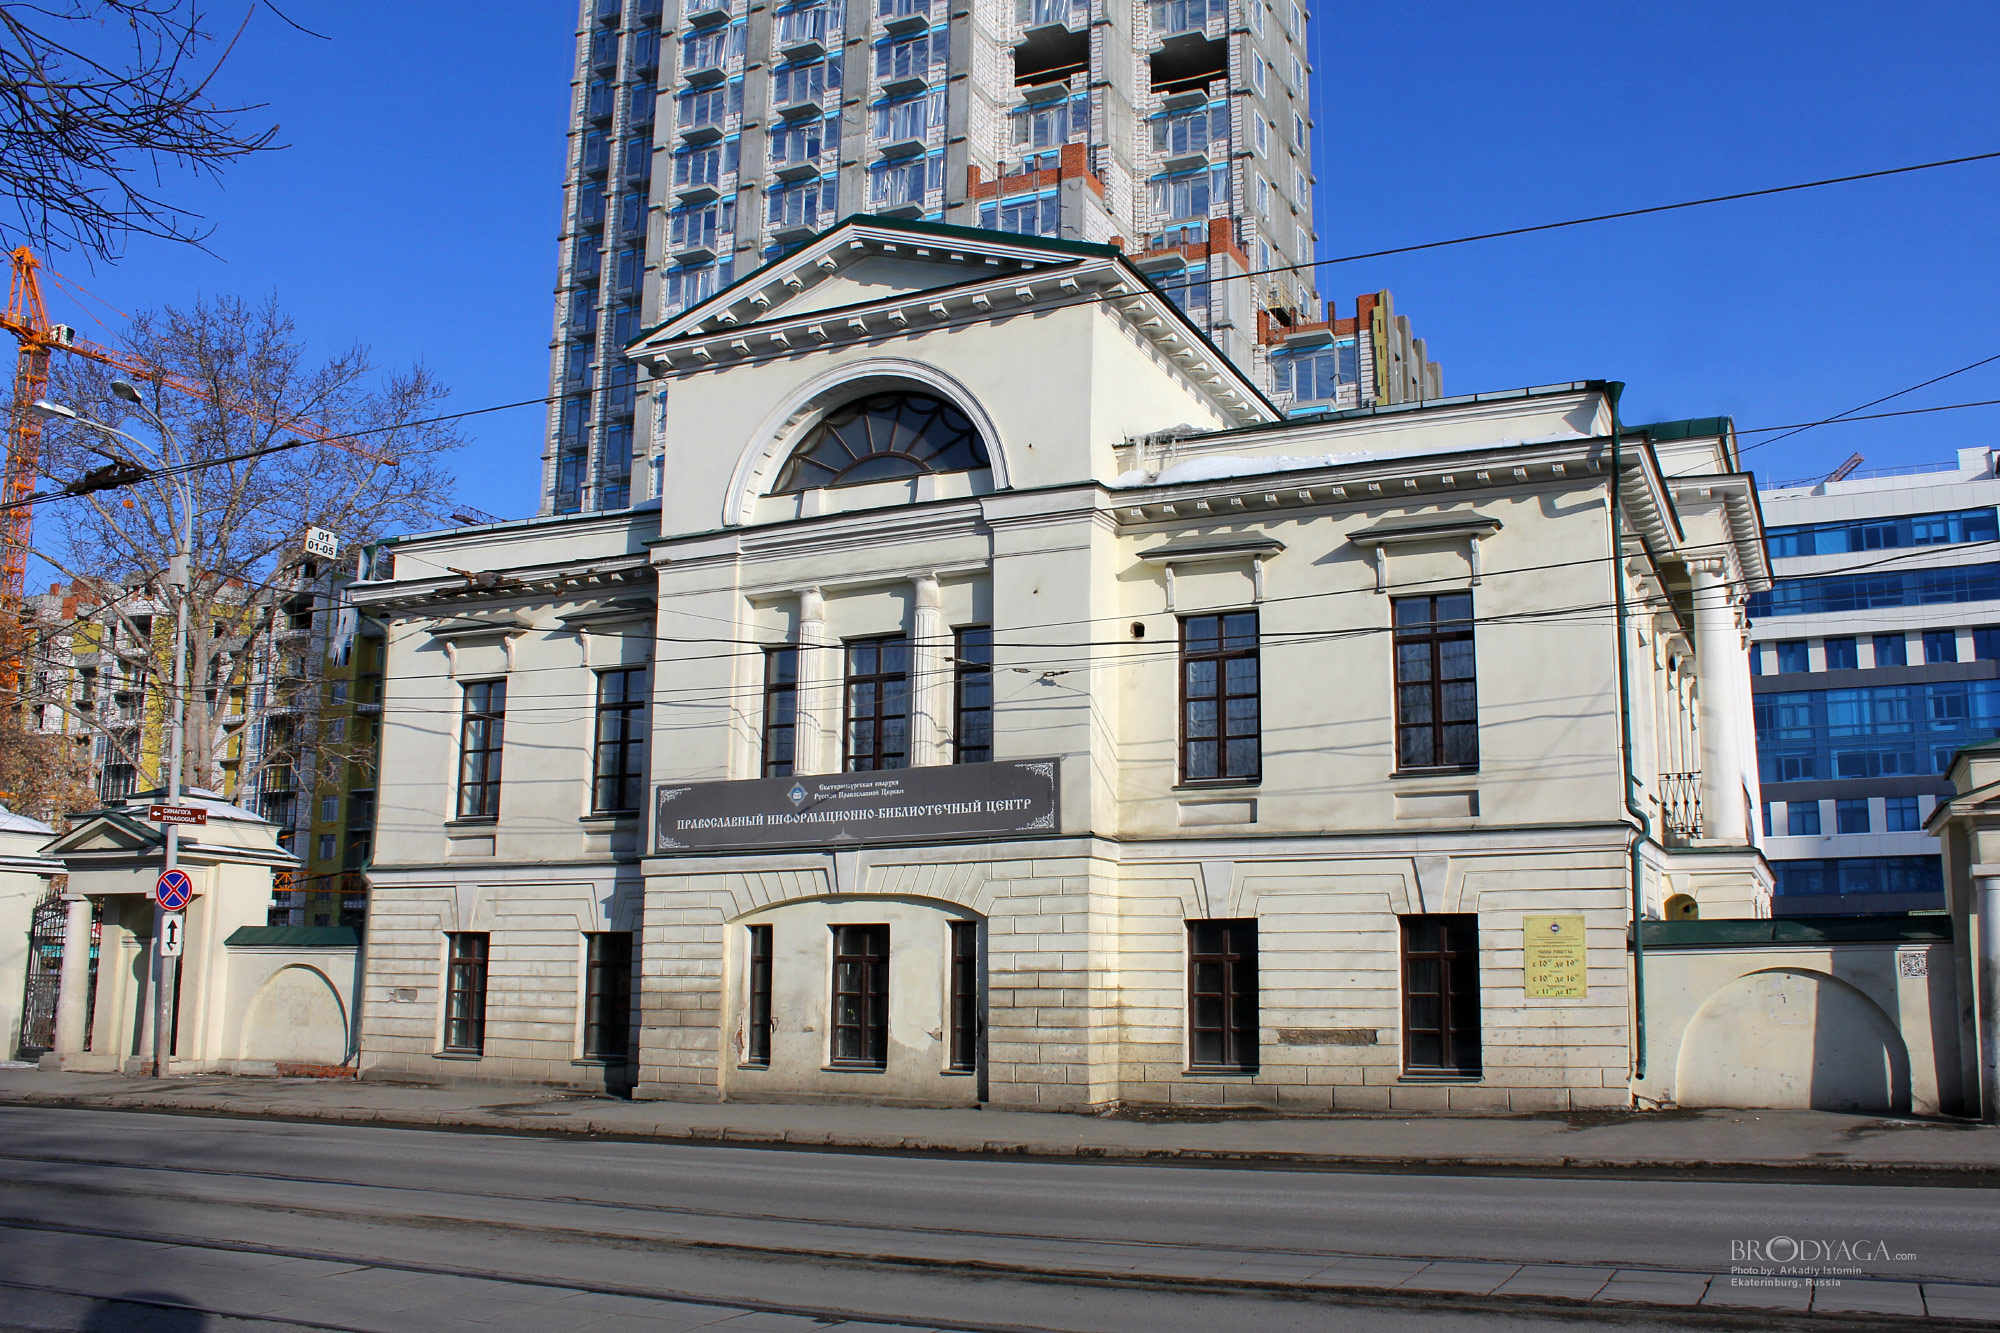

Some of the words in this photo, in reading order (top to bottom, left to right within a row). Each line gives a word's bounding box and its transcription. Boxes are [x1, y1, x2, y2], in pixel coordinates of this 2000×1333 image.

[319, 532, 330, 542] 01
[308, 540, 334, 555] 01-05
[838, 789, 880, 799] Православной
[881, 788, 904, 796] Церкви
[163, 815, 196, 823] SYNAGOGUE
[677, 813, 764, 830] ПРАВОСЛАВНЫЙ
[767, 800, 982, 825] ИНФОРМАЦИОННО-БИБЛИОТЕЧНЫЙ
[986, 798, 1032, 815] ЦЕНТР
